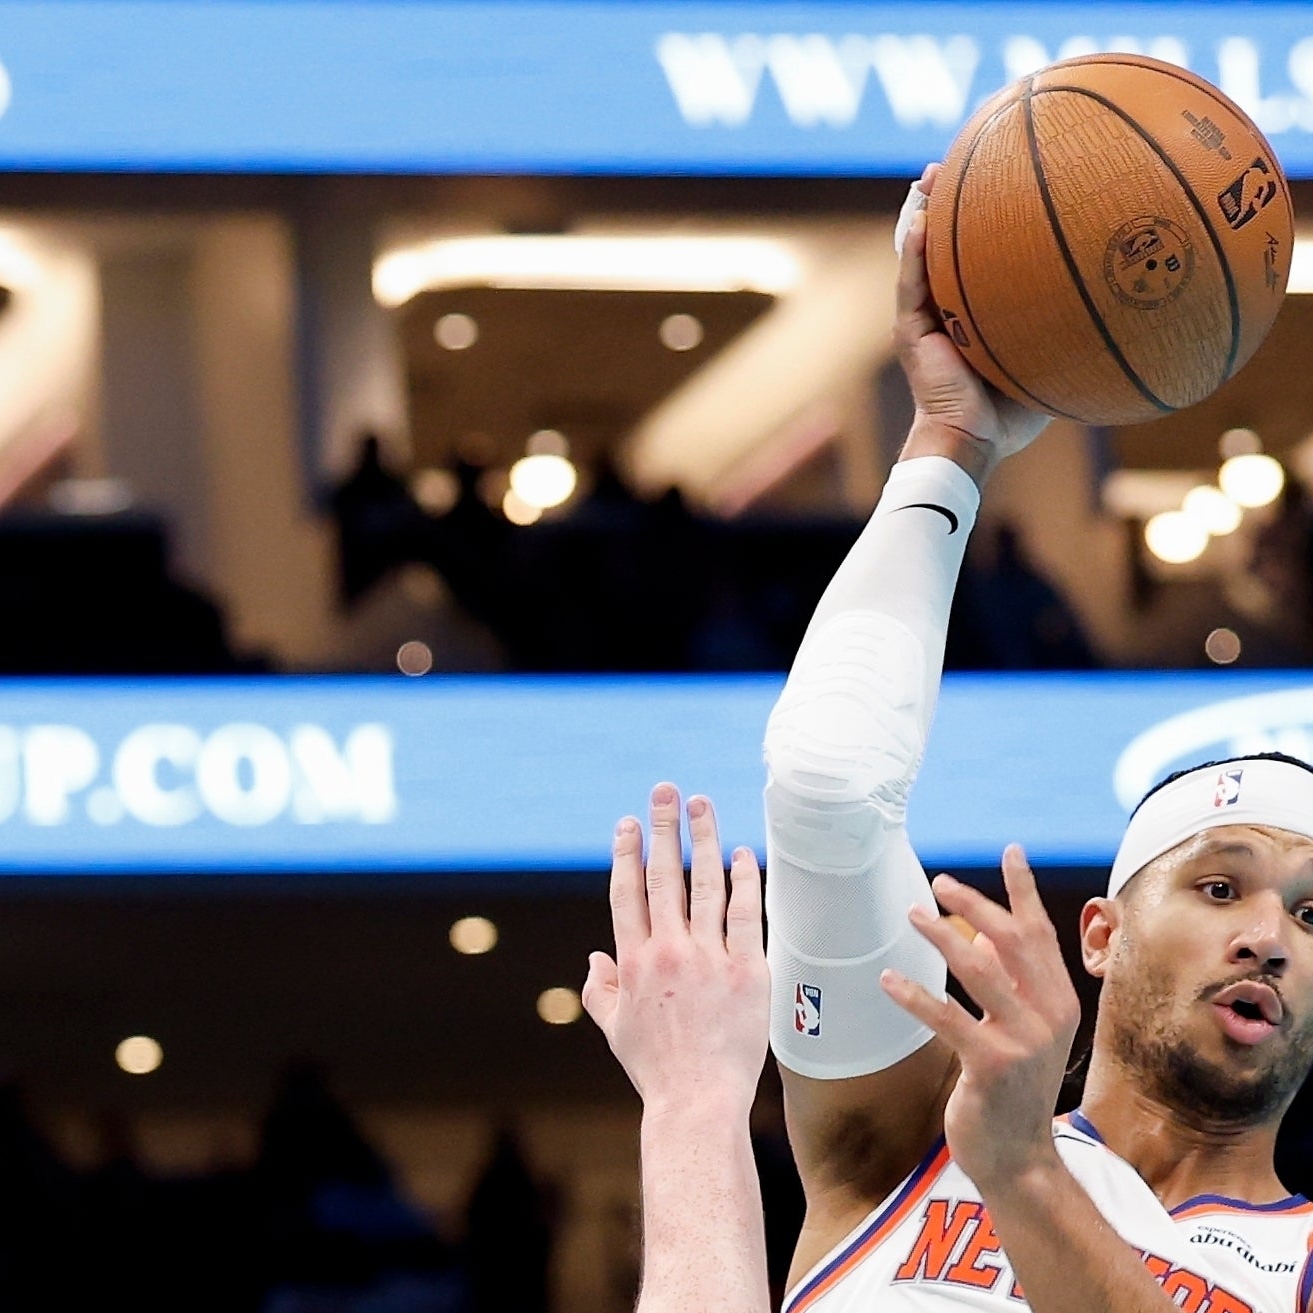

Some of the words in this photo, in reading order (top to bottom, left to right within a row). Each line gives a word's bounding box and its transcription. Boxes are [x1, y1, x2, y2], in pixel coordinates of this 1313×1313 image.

[892, 1198, 1027, 1300] NE
[1190, 1233, 1233, 1248] abu
[1236, 1246, 1298, 1273] dhabi
